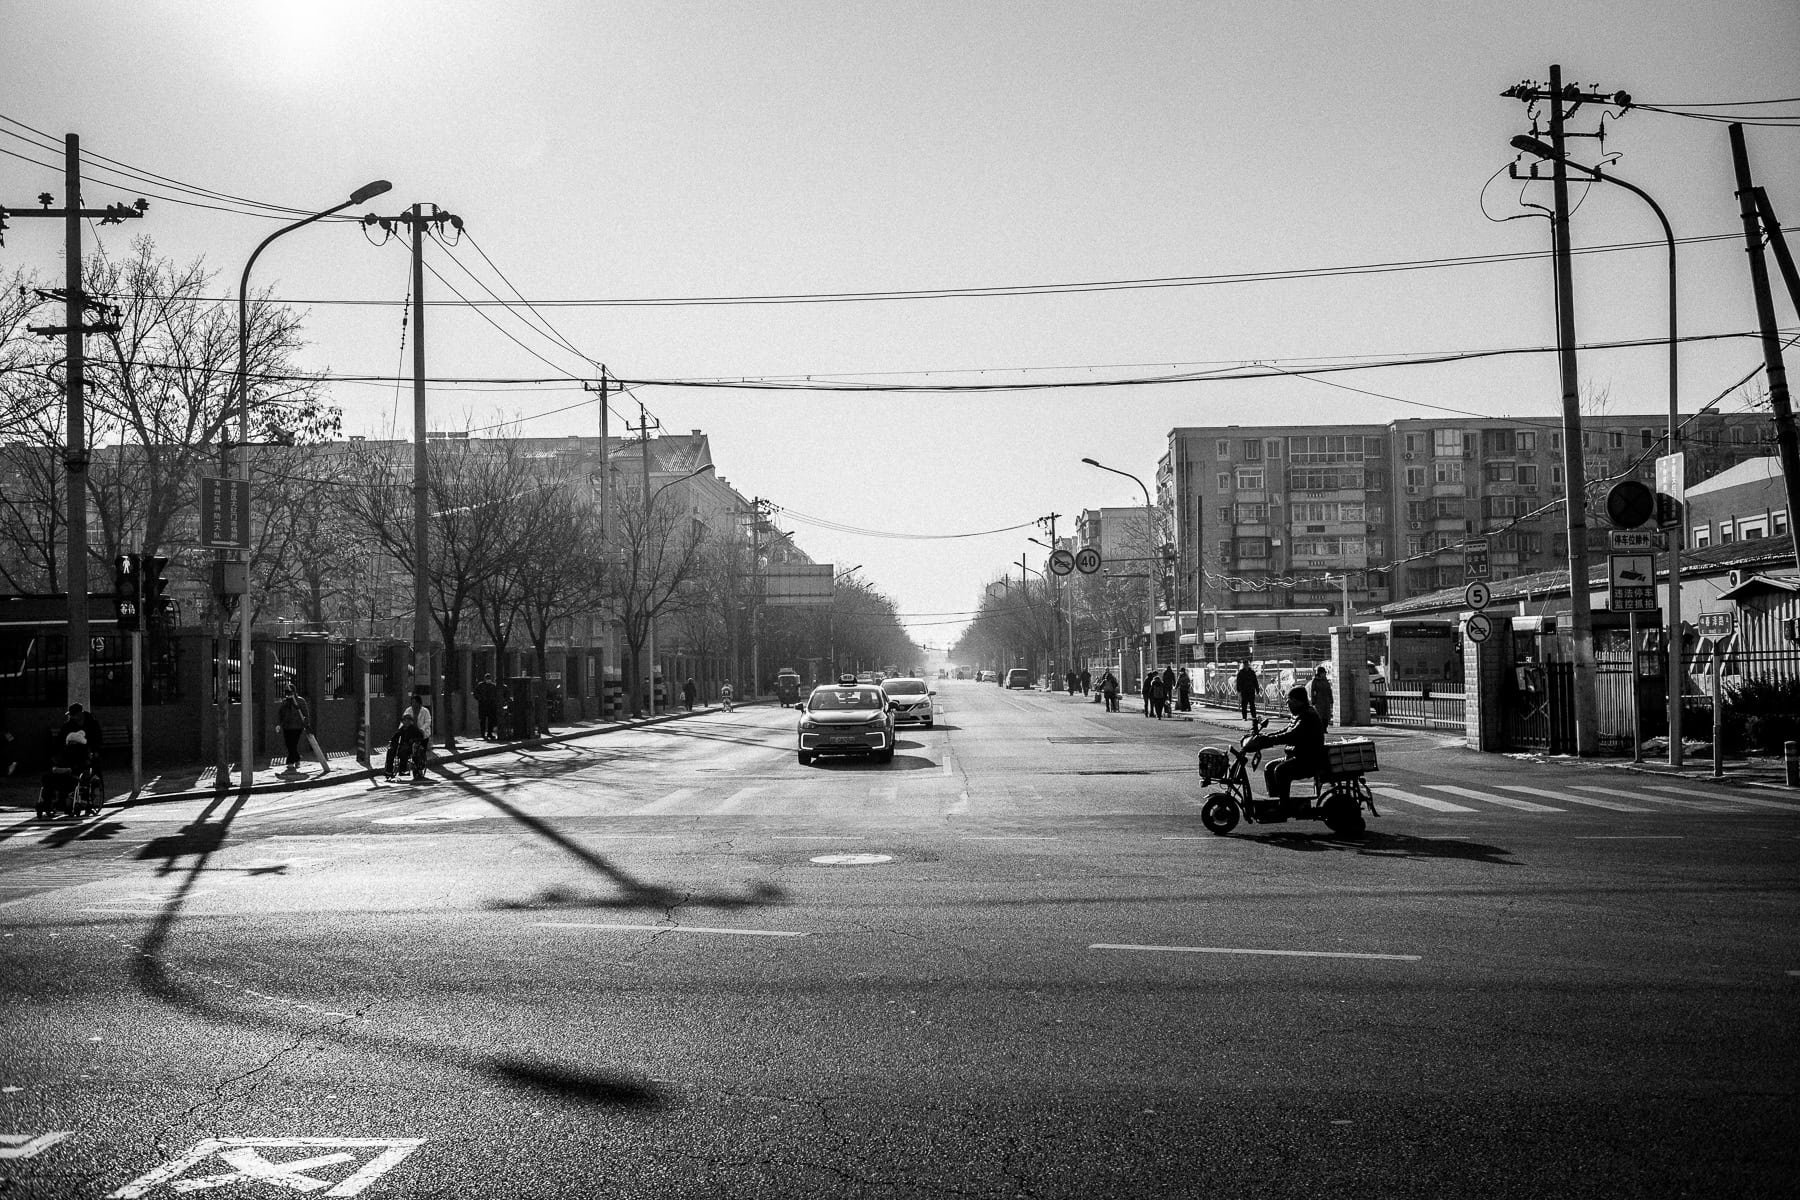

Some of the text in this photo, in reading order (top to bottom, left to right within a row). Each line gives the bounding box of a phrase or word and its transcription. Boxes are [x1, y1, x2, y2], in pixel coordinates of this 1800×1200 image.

[1614, 534, 1650, 545] 停车位除外
[1080, 556, 1096, 568] 40
[1467, 564, 1487, 575] 入口
[1473, 589, 1483, 603] 5
[1614, 588, 1654, 598] 违法停车
[1614, 599, 1654, 610] 监控抓拍
